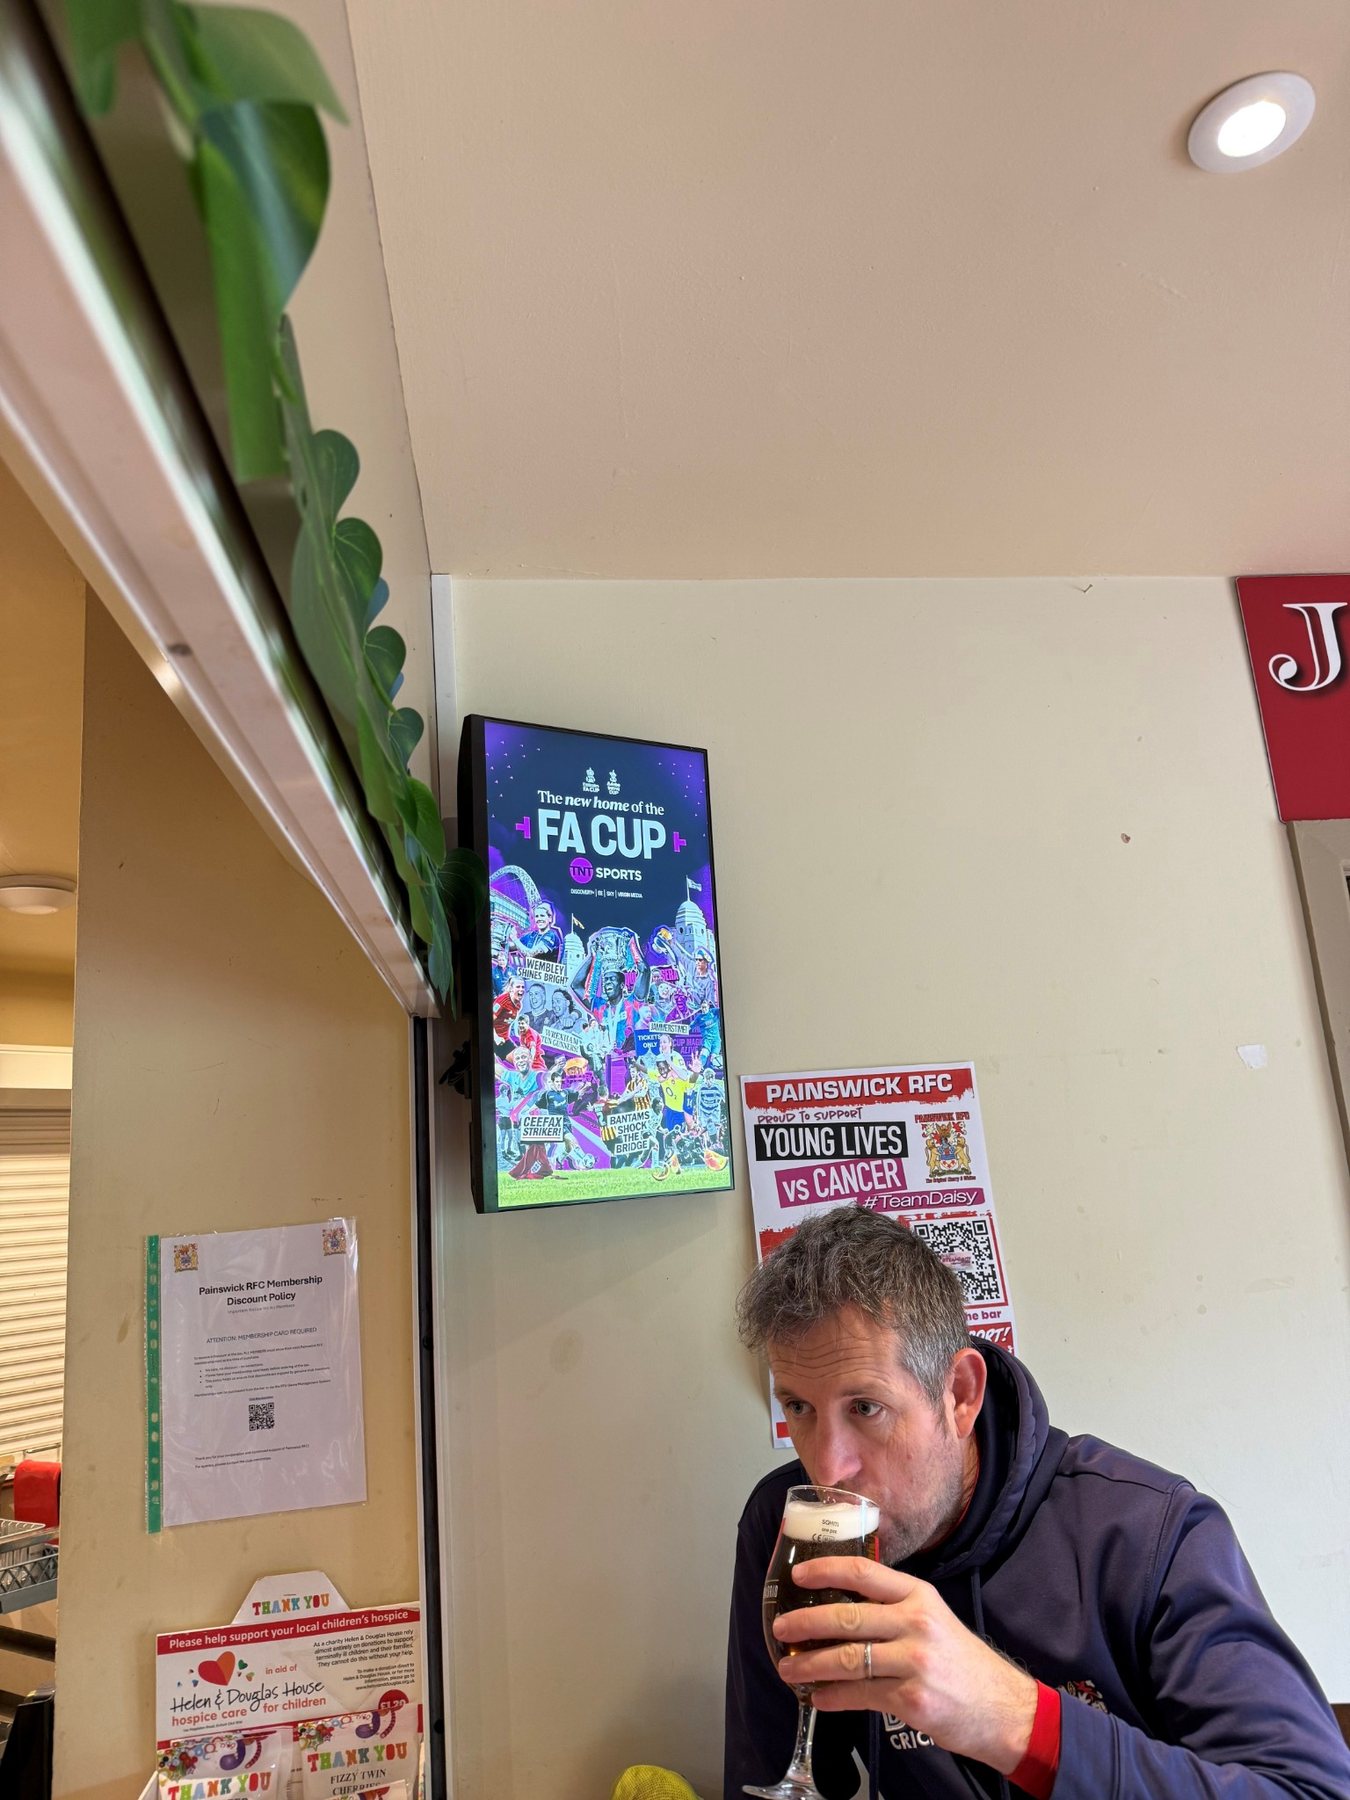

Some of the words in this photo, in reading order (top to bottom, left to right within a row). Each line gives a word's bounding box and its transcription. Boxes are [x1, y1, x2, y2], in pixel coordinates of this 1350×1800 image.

[1269, 602, 1348, 691] J
[538, 790, 562, 804] The
[565, 796, 592, 807] new
[593, 796, 630, 812] home
[631, 801, 644, 813] of
[645, 802, 664, 816] the
[538, 808, 586, 854] FA
[591, 814, 666, 859] CUP
[570, 866, 593, 877] TNT
[596, 867, 642, 881] SPORTS
[526, 958, 564, 975] WEMBLEY
[518, 968, 542, 980] SHINES
[544, 972, 568, 984] BRIGHT
[766, 1076, 901, 1103] PAINSWICK
[908, 1073, 953, 1094] RFC
[524, 1116, 562, 1127] CEEFAX
[610, 1111, 650, 1125] BANTAMS
[758, 1111, 796, 1124] PROUD
[816, 1107, 863, 1121] SUPPORT
[522, 1128, 562, 1136] STRIKER!
[618, 1121, 648, 1134] SHOCK
[623, 1132, 640, 1142] THE
[760, 1126, 835, 1158] YOUNG
[842, 1125, 902, 1156] LIVES
[616, 1141, 648, 1154] BRIDGE
[813, 1159, 902, 1195] CANCER
[863, 1190, 978, 1209] #TeamDaisy
[199, 1283, 244, 1296] Painswick
[246, 1280, 266, 1290] RFC
[266, 1275, 323, 1288] Membership
[227, 1292, 267, 1306] Discount
[269, 1292, 296, 1301] Policy
[982, 1310, 1002, 1320] bar
[238, 1332, 273, 1340] MEMBERSHIP
[252, 1596, 300, 1616] THANK
[304, 1594, 330, 1609] YOU
[169, 1636, 202, 1650] Please
[205, 1632, 227, 1648] help
[230, 1629, 268, 1645] support
[271, 1626, 294, 1640] your
[296, 1620, 320, 1634] local
[322, 1614, 368, 1630] children's
[371, 1610, 408, 1624] hospice
[314, 1646, 332, 1654] almost
[333, 1644, 352, 1652] entirely
[394, 1636, 414, 1644] support
[326, 1638, 344, 1646] charity
[316, 1652, 342, 1660] terminally
[348, 1648, 369, 1656] children
[266, 1667, 274, 1675] in
[275, 1666, 288, 1674] aid
[289, 1664, 298, 1672] of
[318, 1660, 330, 1668] They
[332, 1658, 350, 1666] cannot
[170, 1694, 211, 1712] Helen
[214, 1688, 222, 1710] &
[227, 1683, 278, 1712] Douglas
[282, 1681, 325, 1697] House
[172, 1711, 218, 1726] hospice
[222, 1708, 247, 1719] care
[263, 1702, 278, 1713] for
[282, 1696, 326, 1711] children
[307, 1748, 370, 1772] THANK
[374, 1742, 408, 1762] YOU
[330, 1772, 358, 1784] FIZZY
[360, 1768, 386, 1780] TWIN
[168, 1778, 232, 1800] THANK
[238, 1772, 272, 1792] YOU
